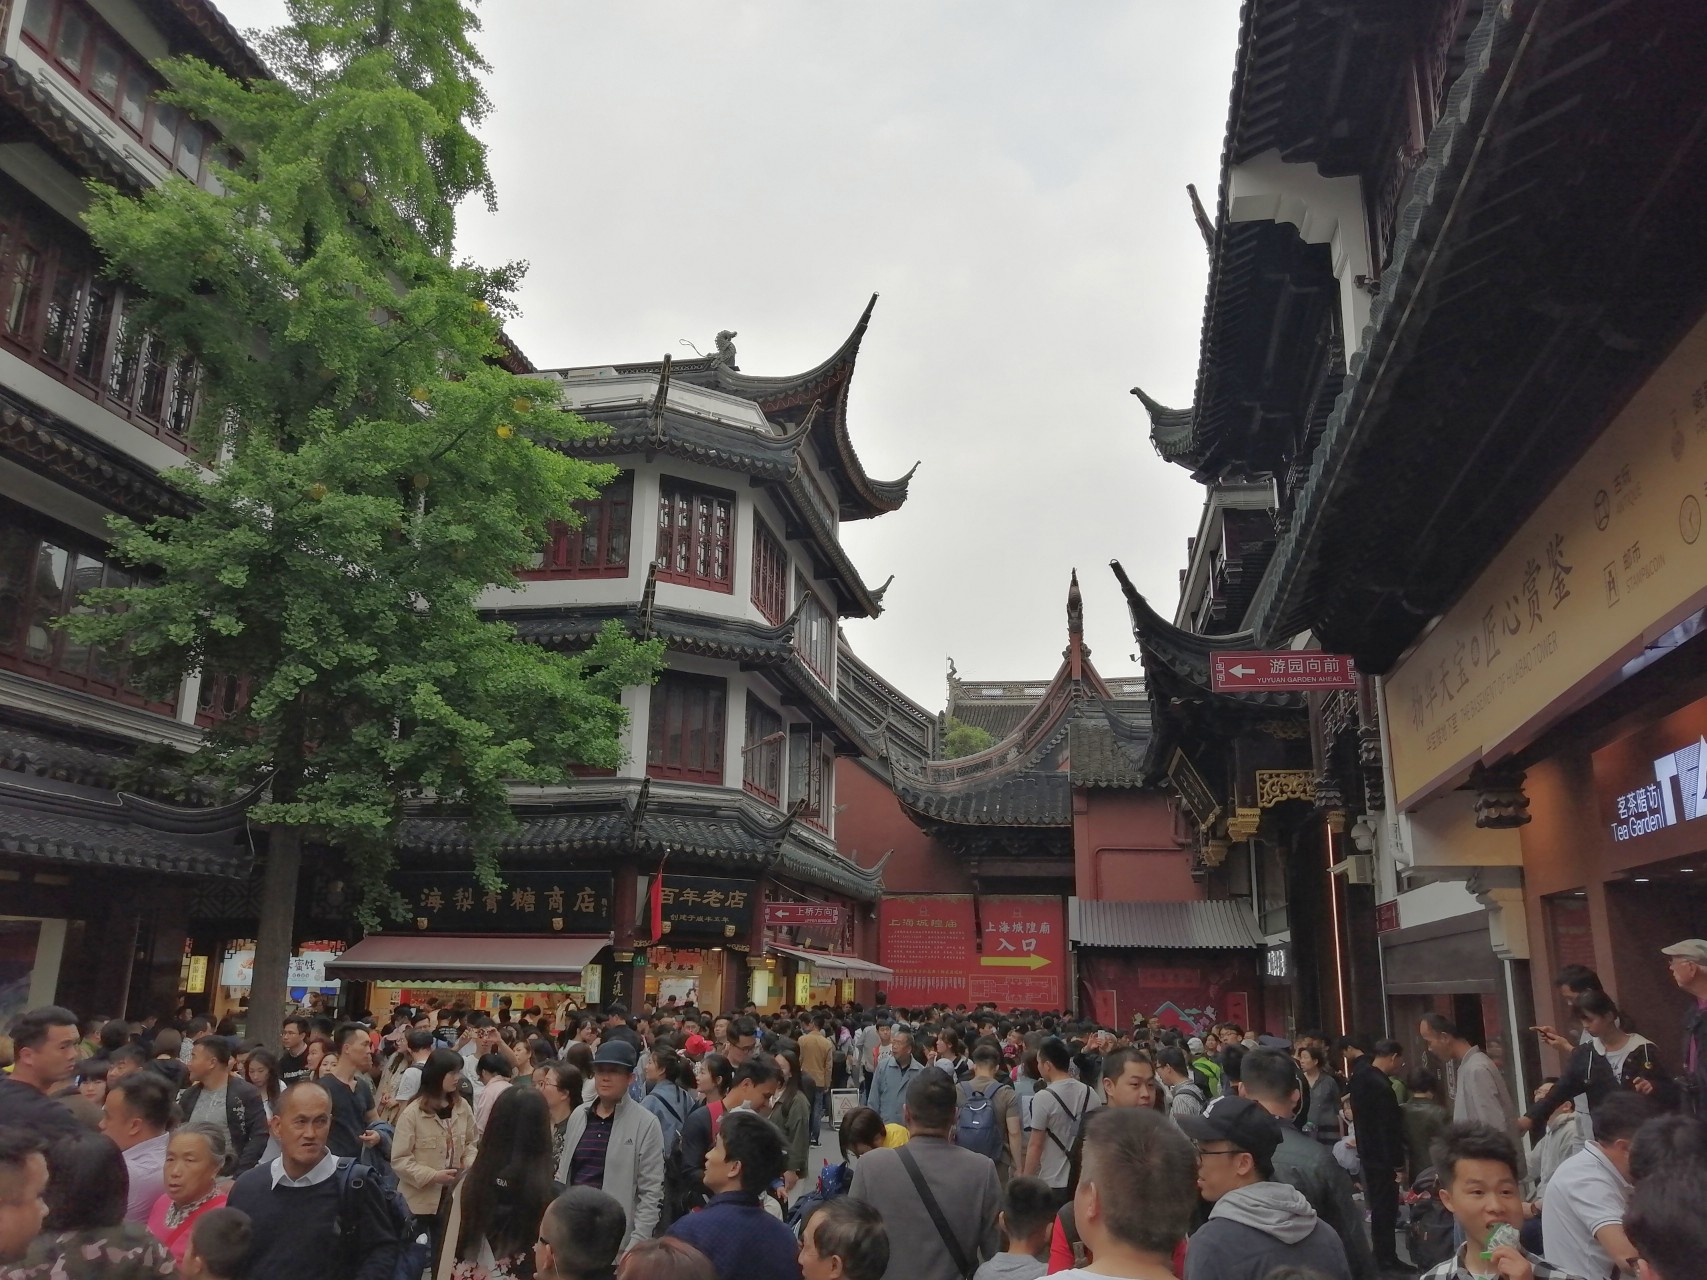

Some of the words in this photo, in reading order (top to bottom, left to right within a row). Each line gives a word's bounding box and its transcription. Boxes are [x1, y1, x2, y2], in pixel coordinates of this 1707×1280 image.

[1482, 532, 1573, 668] 匠心赏鉴
[1532, 630, 1559, 667] TOWER
[1269, 658, 1340, 674] 游园向前
[1611, 822, 1630, 842] Tea
[1629, 810, 1662, 837] Garden
[661, 887, 748, 909] 百年老店
[795, 907, 833, 917] 上桥方向
[996, 937, 1038, 952] 入口
